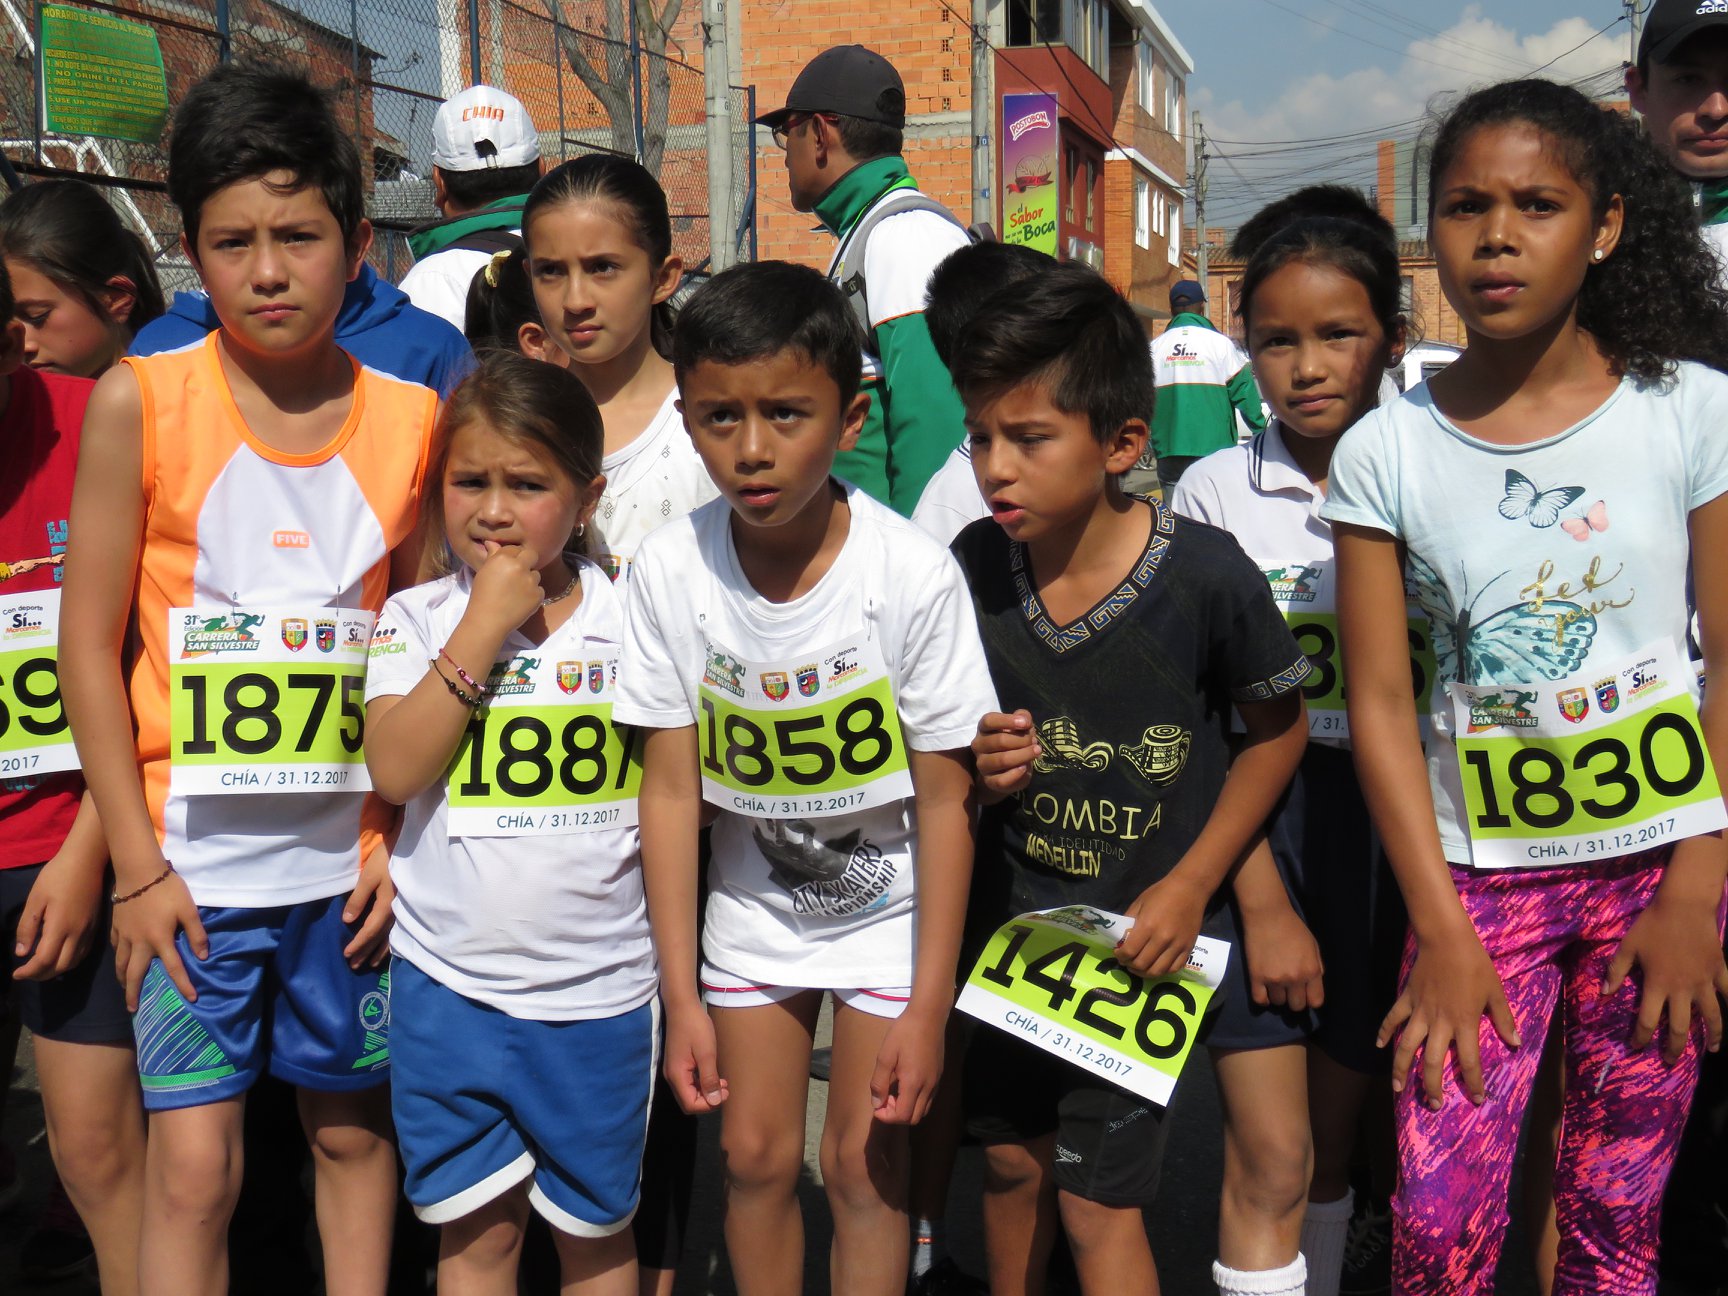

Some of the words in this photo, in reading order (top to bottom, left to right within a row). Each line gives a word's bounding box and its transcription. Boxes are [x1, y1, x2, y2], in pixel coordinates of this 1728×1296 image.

[43, 8, 78, 21] HORARIO
[75, 72, 103, 80] ORINE
[133, 81, 164, 91] PARQUE
[1009, 206, 1044, 228] Sabor
[1017, 203, 1023, 214] el
[1023, 220, 1056, 242] Boca
[276, 534, 307, 545] FIVE
[3, 607, 16, 615] Con
[12, 613, 42, 628] Sí...
[187, 632, 238, 642] CARRERA
[187, 642, 208, 650] SAN
[209, 641, 259, 650] SILVESTRE
[824, 656, 836, 665] Con
[834, 657, 858, 675] Sí...
[1622, 667, 1635, 677] Con
[1633, 669, 1657, 688] Sí...
[0, 657, 69, 739] 9
[182, 673, 364, 754] 1875
[1472, 717, 1492, 725] SAN
[1495, 717, 1538, 726] SILVESTRE
[702, 697, 892, 786] 1858
[461, 715, 638, 797] 1887
[221, 770, 259, 786] CHÍA
[264, 772, 272, 786] /
[277, 771, 348, 785] 31.12.2017
[1465, 712, 1705, 828] 1830
[734, 796, 766, 812] CHÍA
[771, 802, 776, 813] /
[782, 792, 866, 813] 31.12.2017
[496, 812, 534, 829] CHÍA
[538, 815, 547, 829] /
[551, 809, 620, 827] 31.12.2017
[1018, 791, 1161, 840] LOMBIA
[1528, 842, 1568, 859] CHÍA
[1573, 843, 1580, 856] /
[1587, 818, 1675, 852] 31.12.2017
[1026, 833, 1101, 878] MEDELLIN
[823, 838, 882, 904] SKATERS
[813, 859, 898, 916] AMPIONSHIP
[981, 924, 1197, 1060] 1426
[1005, 1010, 1038, 1036] CHÍA
[1053, 1033, 1133, 1076] 31.12.2017
[1056, 1144, 1082, 1163] speedo
